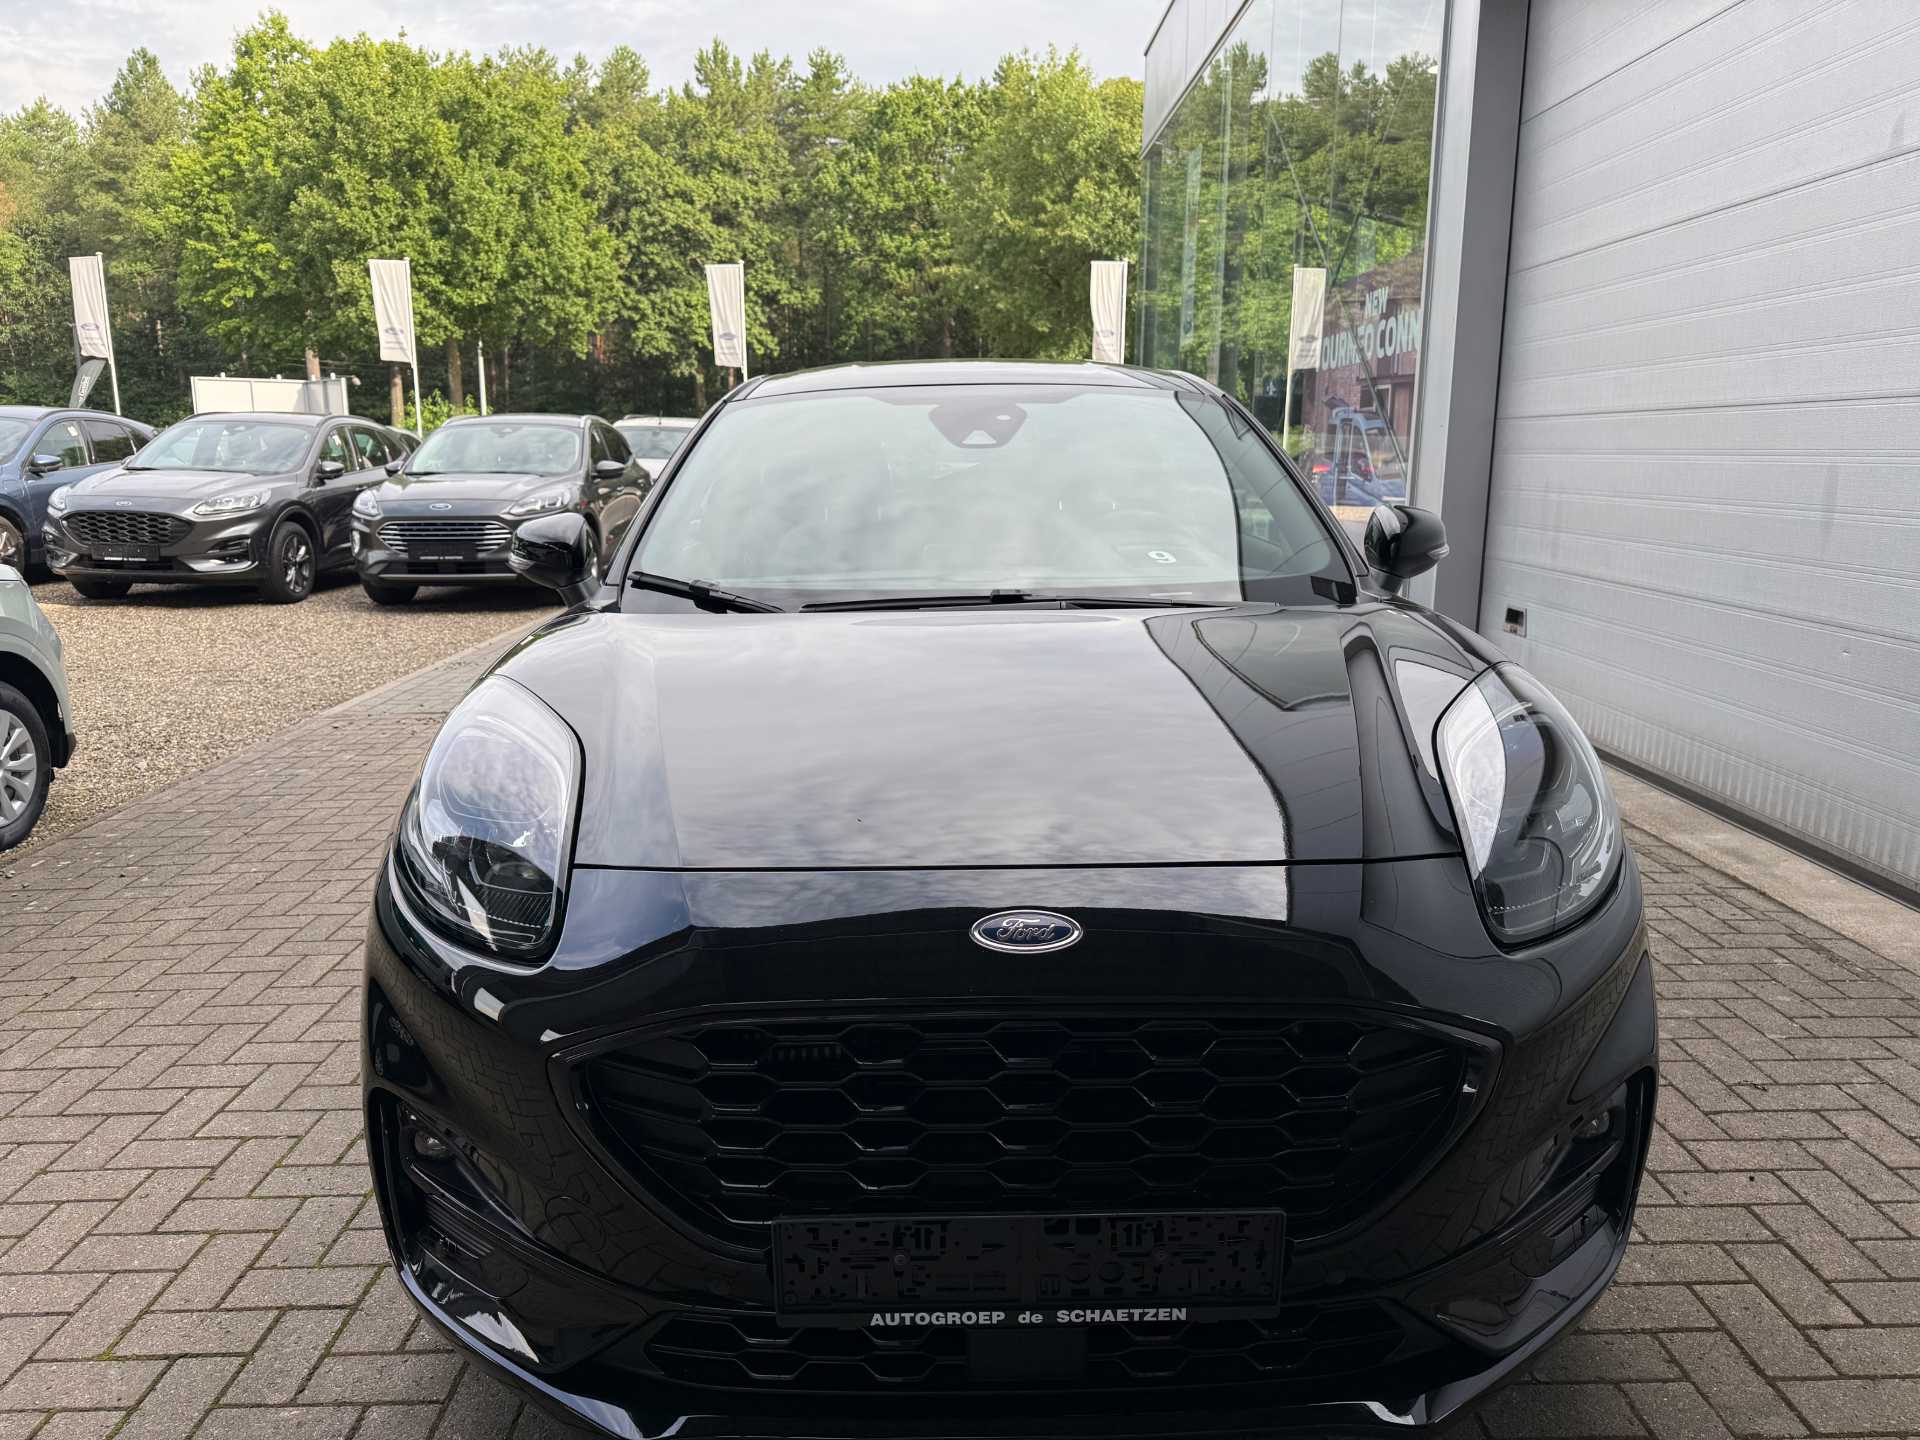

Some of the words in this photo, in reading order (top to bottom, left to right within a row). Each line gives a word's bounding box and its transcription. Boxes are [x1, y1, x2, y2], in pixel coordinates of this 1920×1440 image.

[1365, 286, 1389, 319] NEW
[1321, 323, 1375, 371] OURNEO
[996, 918, 1056, 941] Ford
[870, 1311, 1006, 1326] AUTOGROEP
[1018, 1310, 1044, 1323] de
[1056, 1308, 1187, 1323] SCHAETZEN
